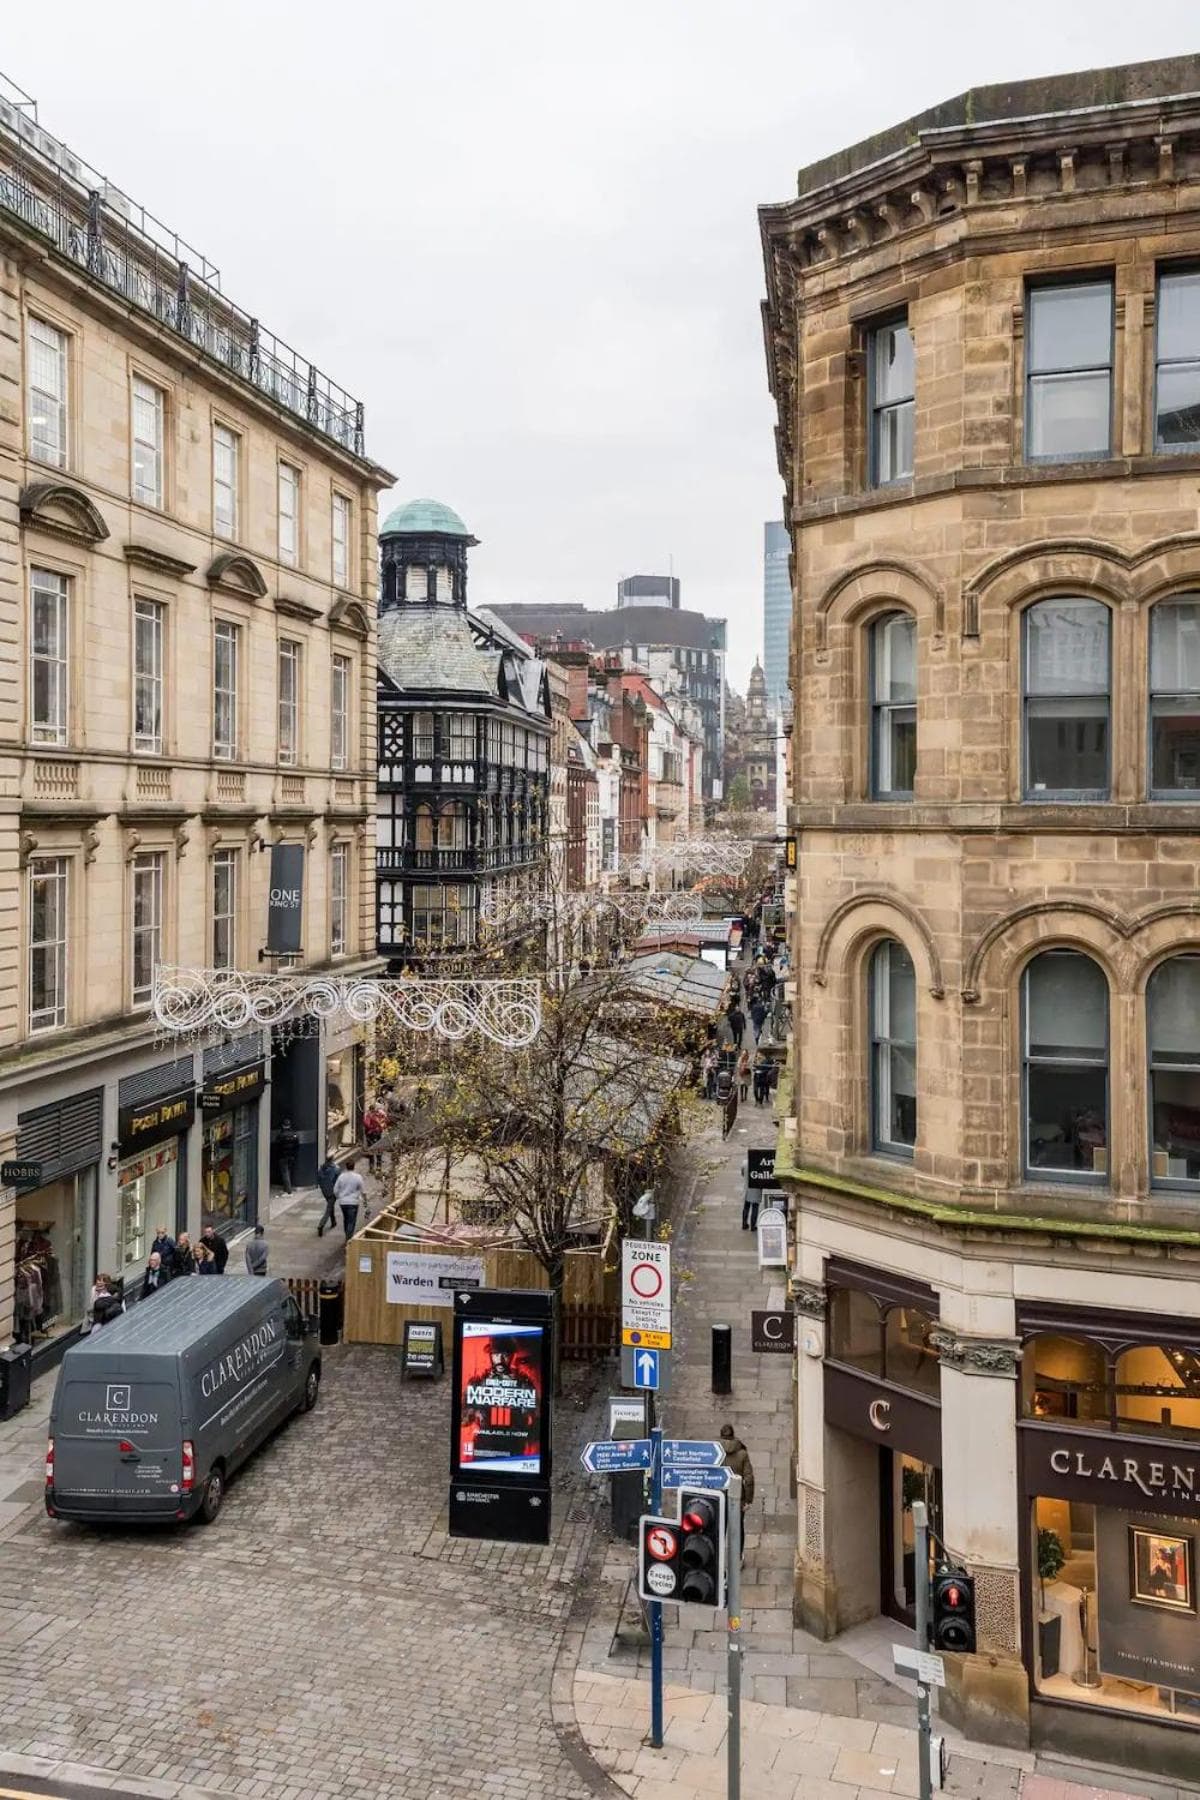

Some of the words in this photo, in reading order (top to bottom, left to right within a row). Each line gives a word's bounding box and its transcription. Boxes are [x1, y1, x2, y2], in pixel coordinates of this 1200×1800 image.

[270, 889, 300, 901] ONE
[270, 900, 288, 908] KING
[4, 1167, 41, 1178] HOBBS
[625, 1241, 667, 1251] PEDESTRIAN
[631, 1251, 662, 1262] ZONE
[392, 1274, 433, 1288] Warden
[762, 1316, 782, 1340] C
[201, 1319, 276, 1398] CLARENDON
[113, 1392, 124, 1404] C
[466, 1386, 536, 1398] MODERN
[466, 1396, 536, 1408] WARFARE
[78, 1412, 158, 1426] CLARENDON
[870, 1400, 890, 1431] C
[650, 1570, 674, 1583] Except
[650, 1580, 673, 1589] cycles
